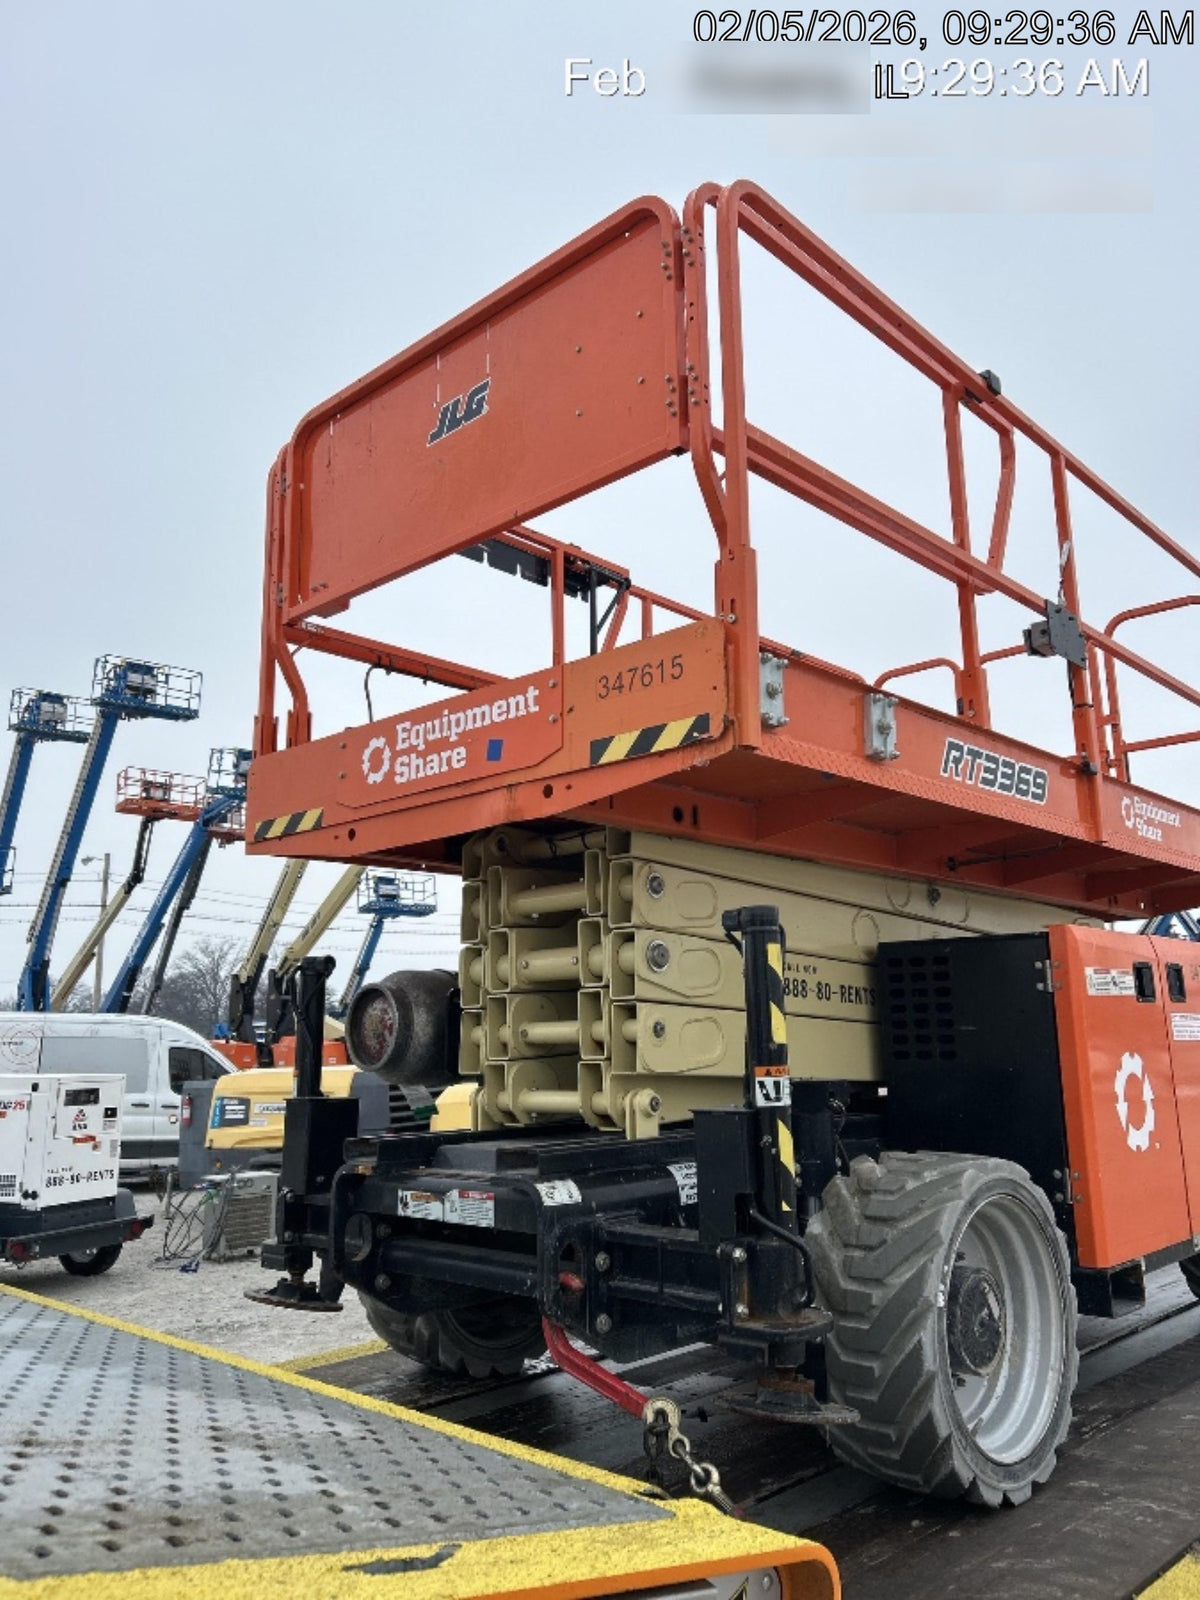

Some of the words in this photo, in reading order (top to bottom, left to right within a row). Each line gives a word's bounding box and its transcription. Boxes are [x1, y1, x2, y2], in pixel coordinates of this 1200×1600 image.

[426, 376, 491, 447] JLG
[597, 653, 685, 700] 347615
[396, 686, 540, 751] Equipment
[394, 745, 467, 785] Share
[940, 737, 1050, 806] RT3369
